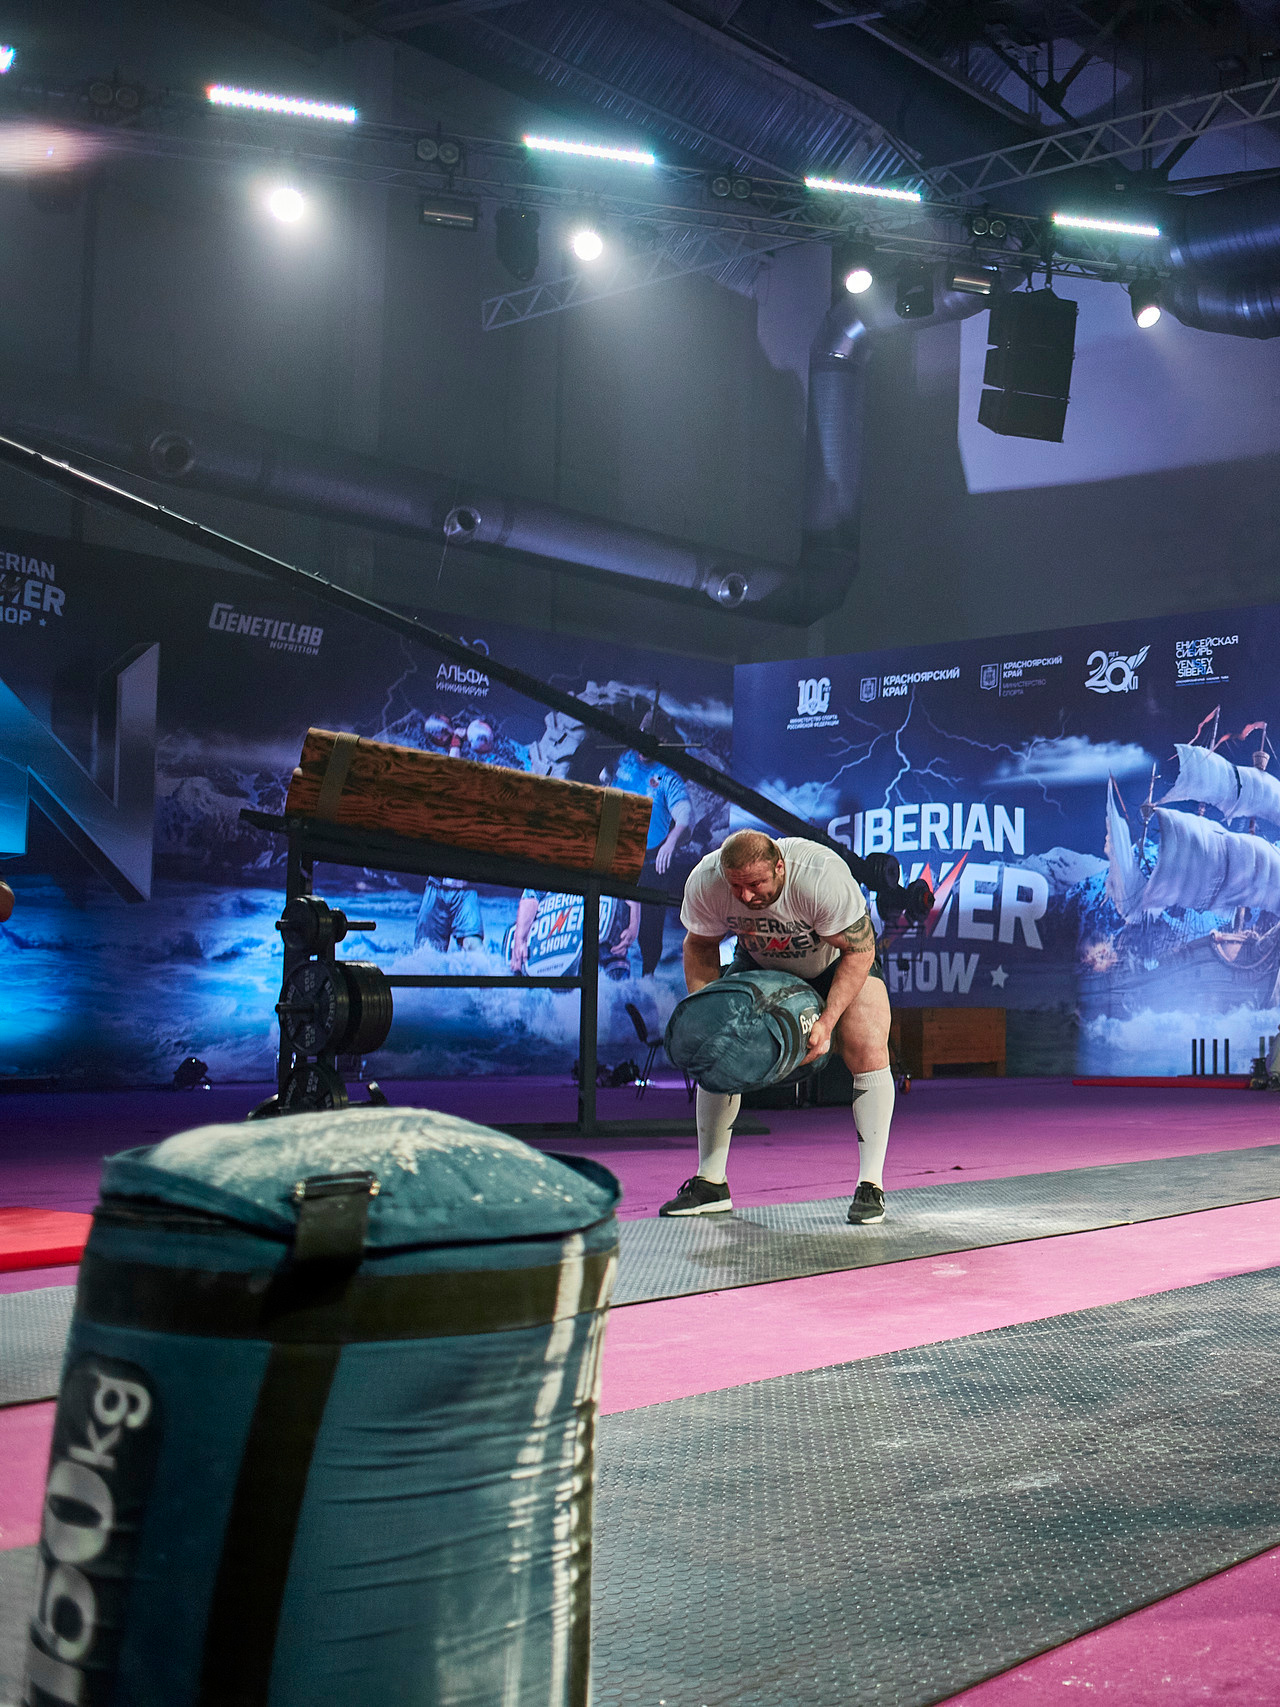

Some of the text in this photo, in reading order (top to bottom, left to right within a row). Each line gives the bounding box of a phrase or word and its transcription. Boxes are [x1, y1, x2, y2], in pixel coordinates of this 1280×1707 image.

[269, 641, 320, 656] NUTRITION
[1003, 655, 1063, 670] КРАСНОЯРСКИЙ
[436, 663, 490, 687] АЛЬФА
[883, 666, 960, 686] КРАСНОЯРСКИЙ
[1003, 669, 1023, 679] КРАЙ
[882, 683, 909, 698] КРАЙ
[827, 802, 1025, 857] SIBERIAN
[540, 932, 572, 955] SHOW
